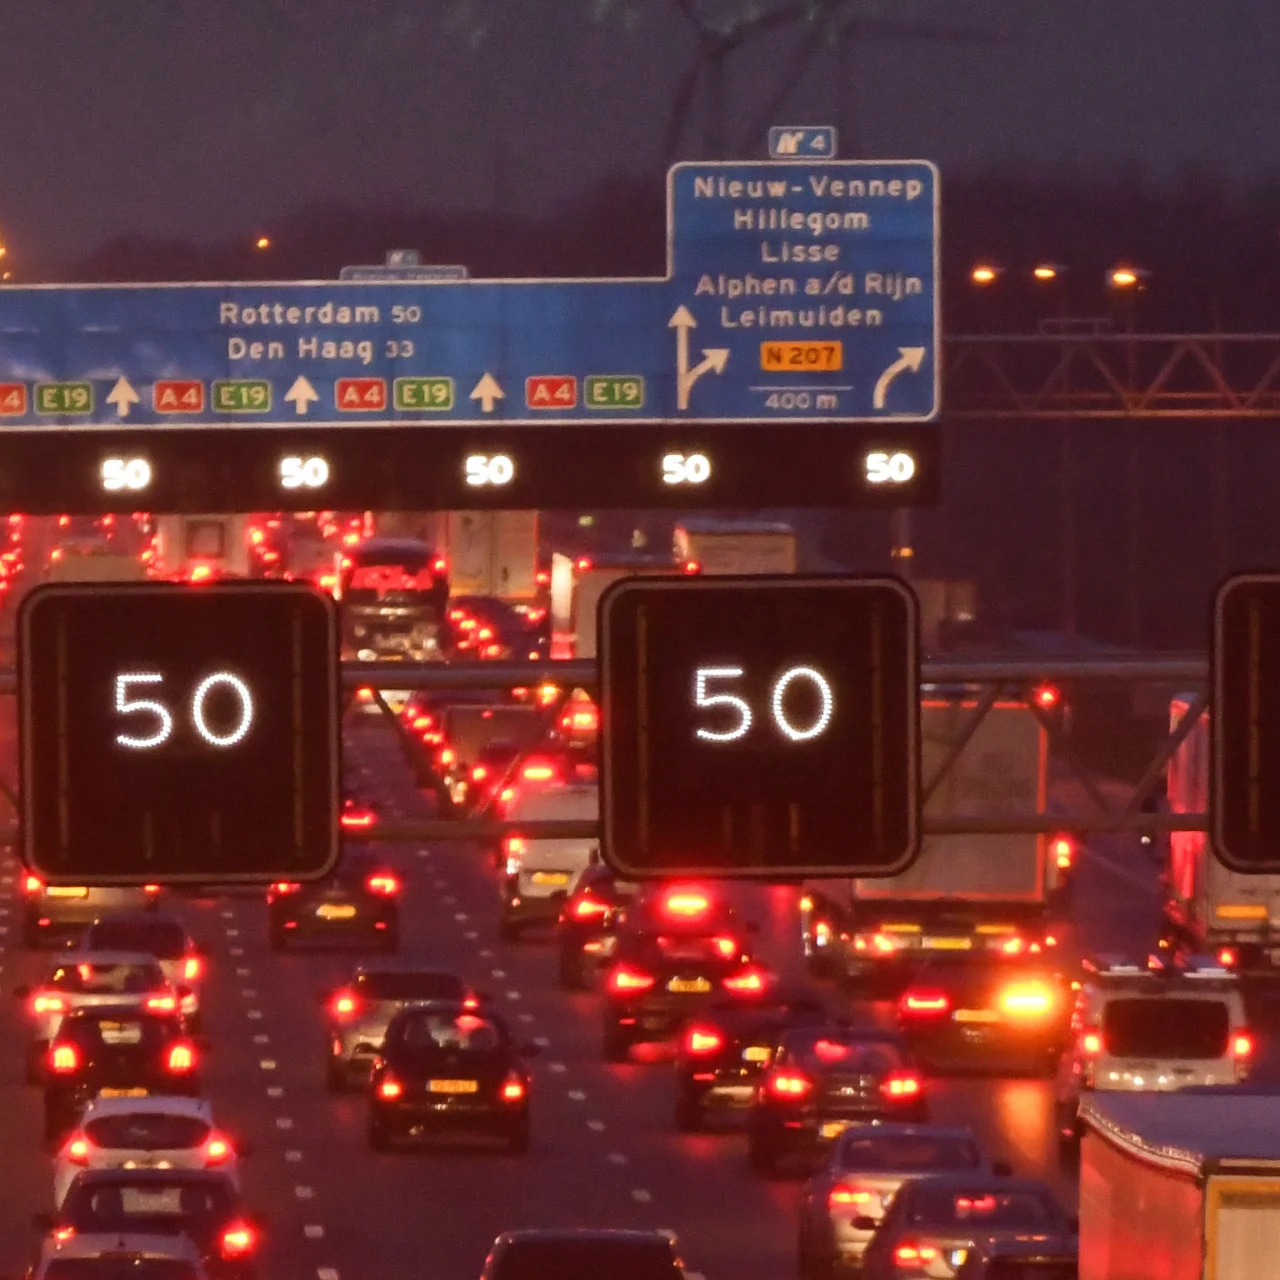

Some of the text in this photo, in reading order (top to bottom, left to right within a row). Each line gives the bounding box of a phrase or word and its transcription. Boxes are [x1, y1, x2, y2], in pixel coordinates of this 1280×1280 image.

[810, 134, 825, 151] 4
[693, 176, 923, 200] Nieuw-Vennep
[734, 208, 870, 234] Hillegom
[761, 241, 839, 263] Lisse
[694, 273, 922, 300] Alphen a/d Rijn
[220, 302, 421, 324] Rotterdam 50
[721, 306, 883, 328] Leimuiden
[228, 337, 415, 364] Den Haag 33
[42, 387, 88, 409] E19
[160, 388, 198, 407] A4
[219, 385, 266, 407] E19
[342, 385, 380, 405] A4
[402, 383, 448, 404] E19
[533, 384, 571, 402] A4
[593, 381, 639, 402] E19
[765, 392, 837, 409] 400 m
[102, 459, 151, 490] 50
[281, 457, 329, 488] 50
[466, 455, 514, 486] 50
[662, 454, 711, 485] 50
[866, 453, 915, 484] 50
[116, 671, 253, 749] 50
[695, 665, 834, 742] 50
